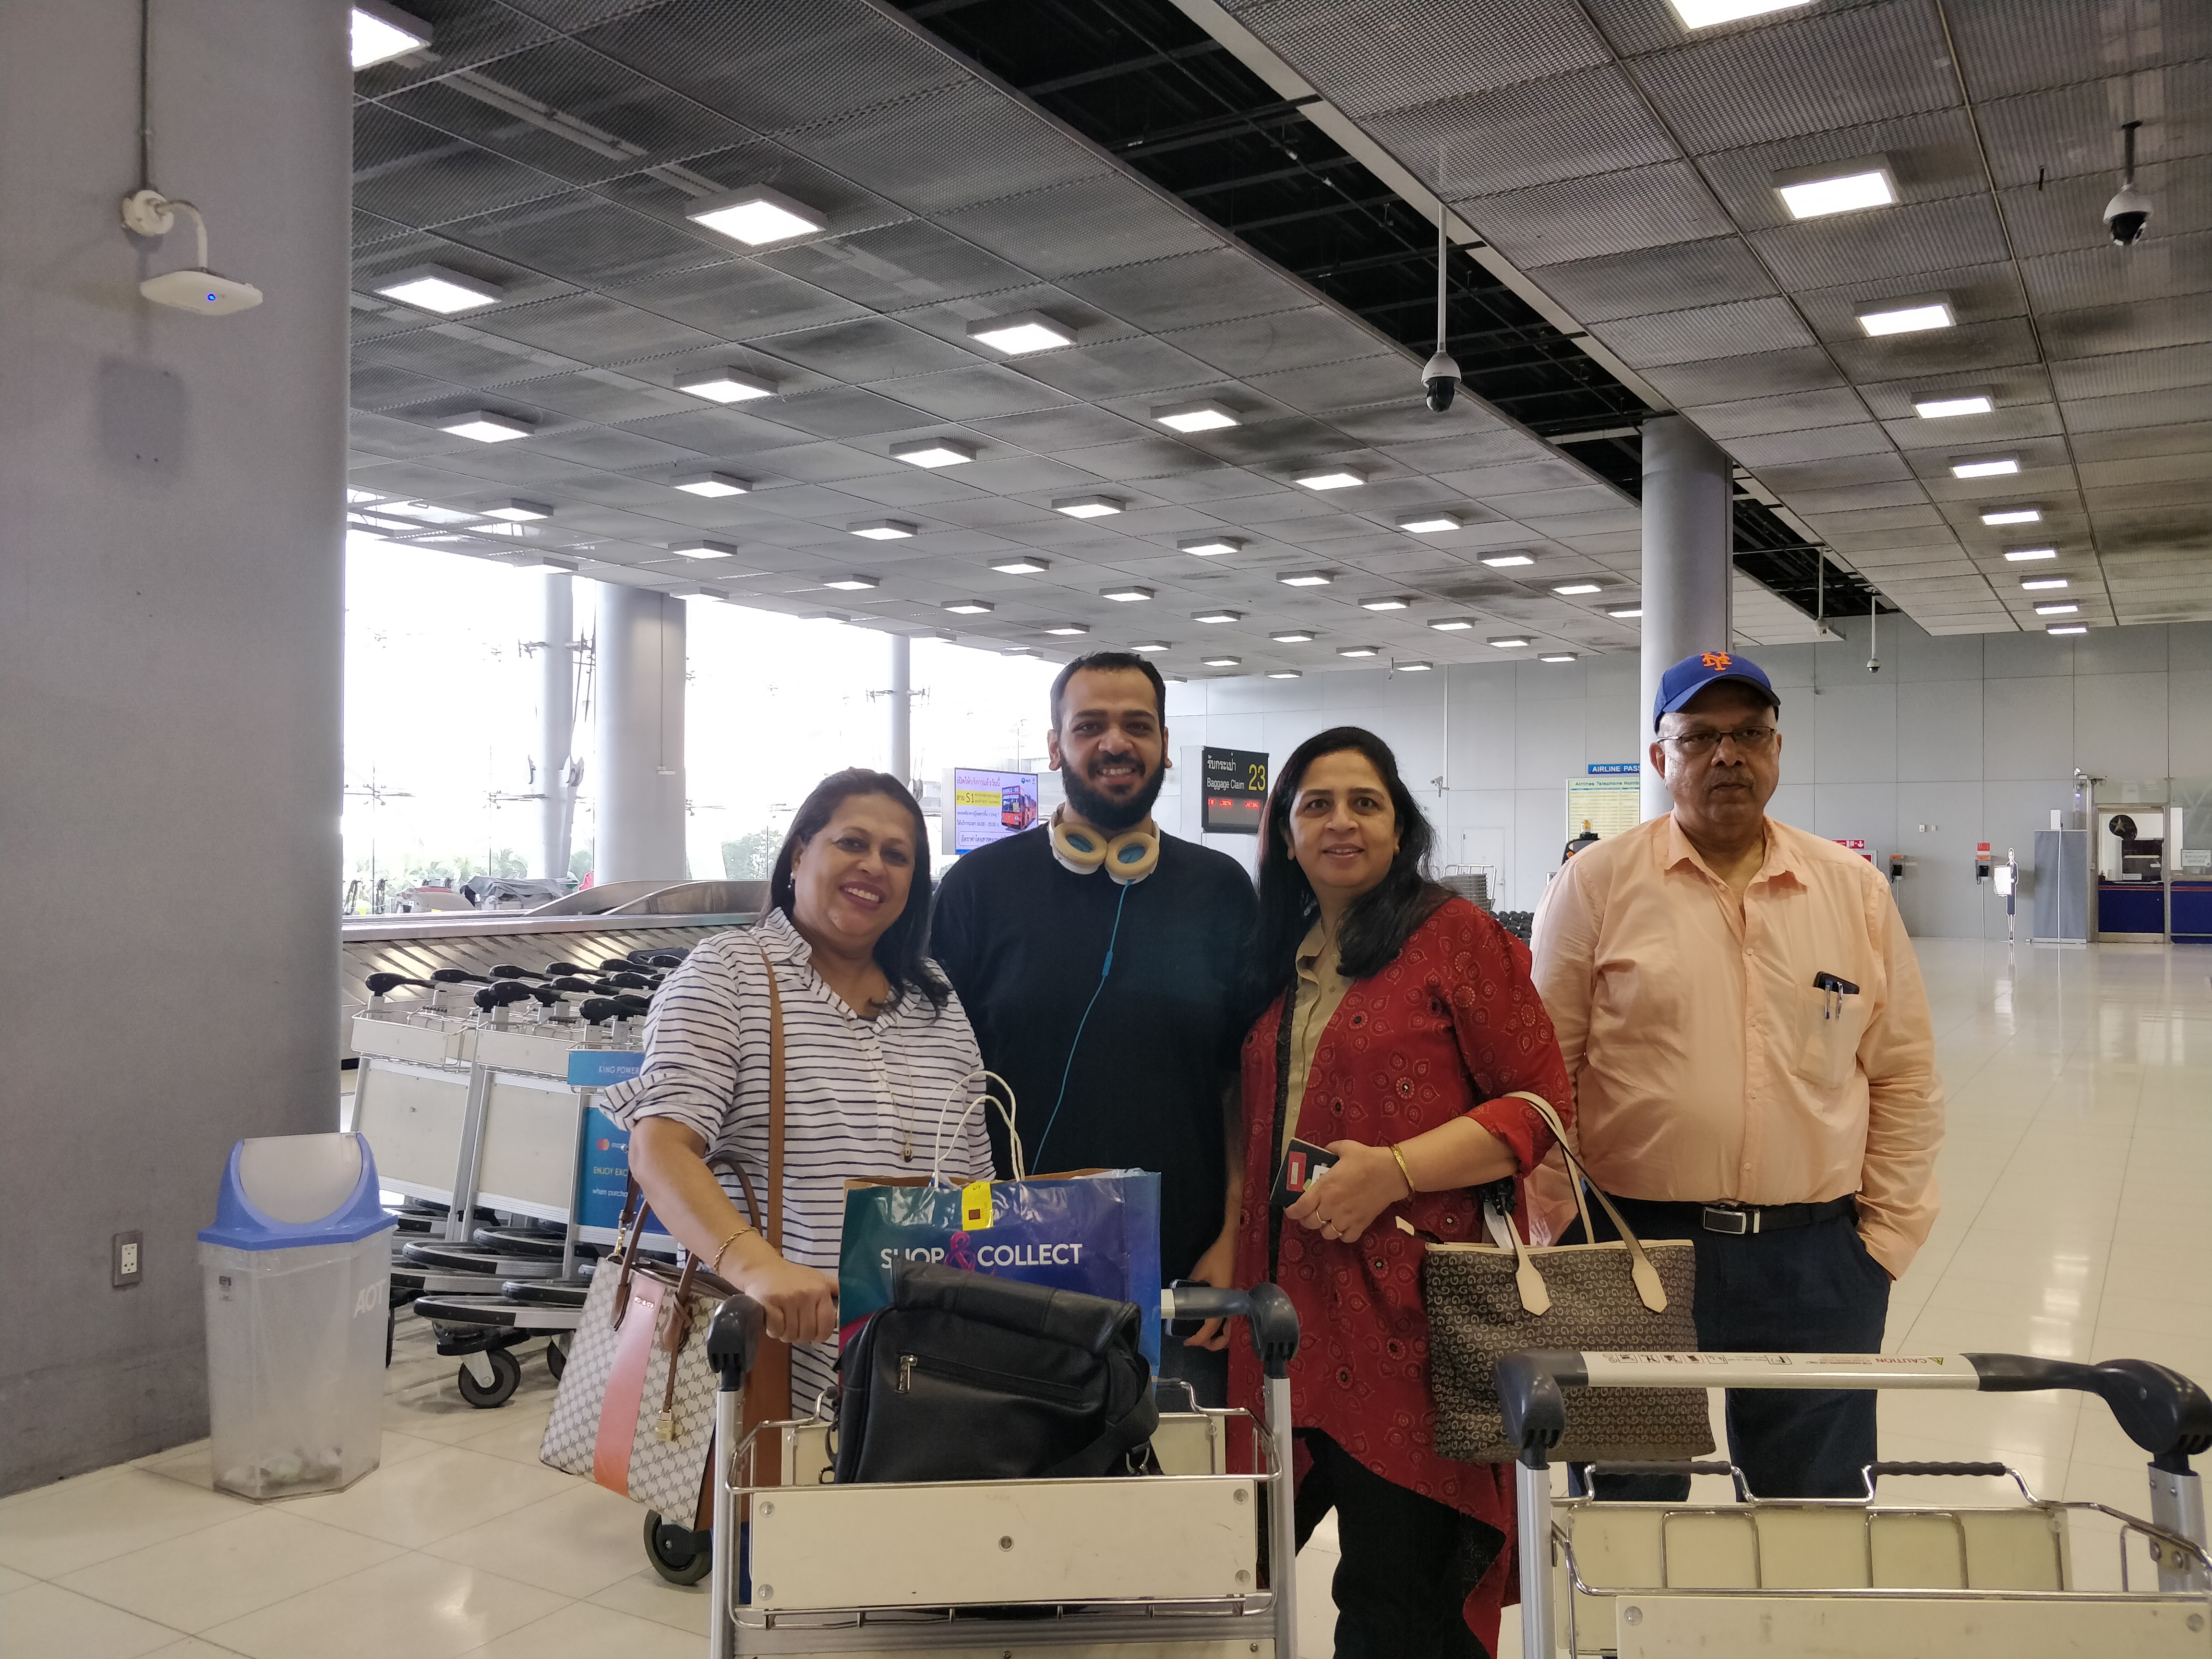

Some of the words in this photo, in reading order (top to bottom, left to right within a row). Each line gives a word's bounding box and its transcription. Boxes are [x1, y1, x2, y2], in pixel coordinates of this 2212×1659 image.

[1207, 777, 1229, 791] Baggage
[1230, 779, 1245, 790] Claim
[1248, 764, 1266, 791] 23
[966, 793, 974, 803] S1
[617, 1066, 640, 1074] POWER
[593, 1166, 614, 1175] ENJOY
[977, 1243, 1083, 1267] COLLECT
[353, 1278, 386, 1319] AOT
